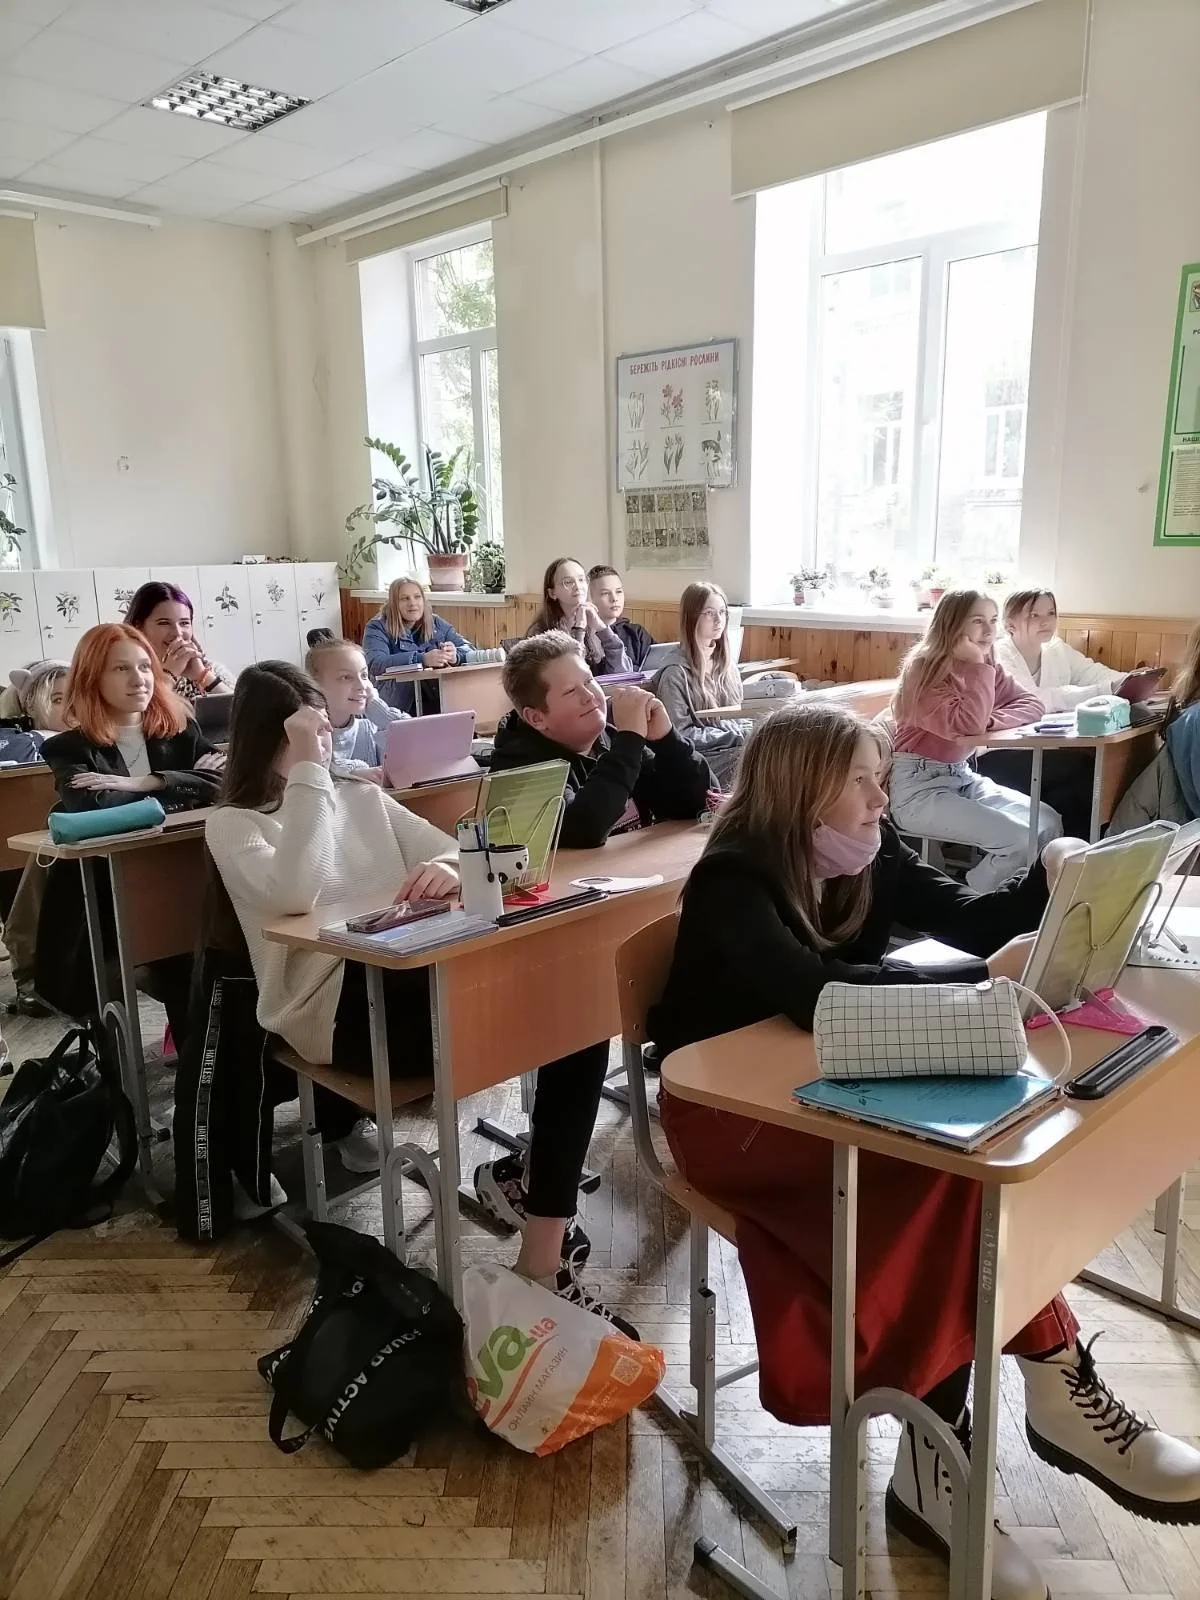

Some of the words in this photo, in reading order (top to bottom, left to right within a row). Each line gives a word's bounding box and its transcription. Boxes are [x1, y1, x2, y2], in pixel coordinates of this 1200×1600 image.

[630, 361, 659, 375] БЕРЕЖІТЬ
[690, 351, 720, 366] РОСЛИНИ
[204, 1049, 215, 1067] HATE
[201, 1067, 213, 1084] LESS
[197, 1143, 207, 1159] LESS
[200, 1215, 210, 1231] LESS
[535, 1347, 568, 1391] МАГАЗИН
[324, 1371, 368, 1442] ACTIVE
